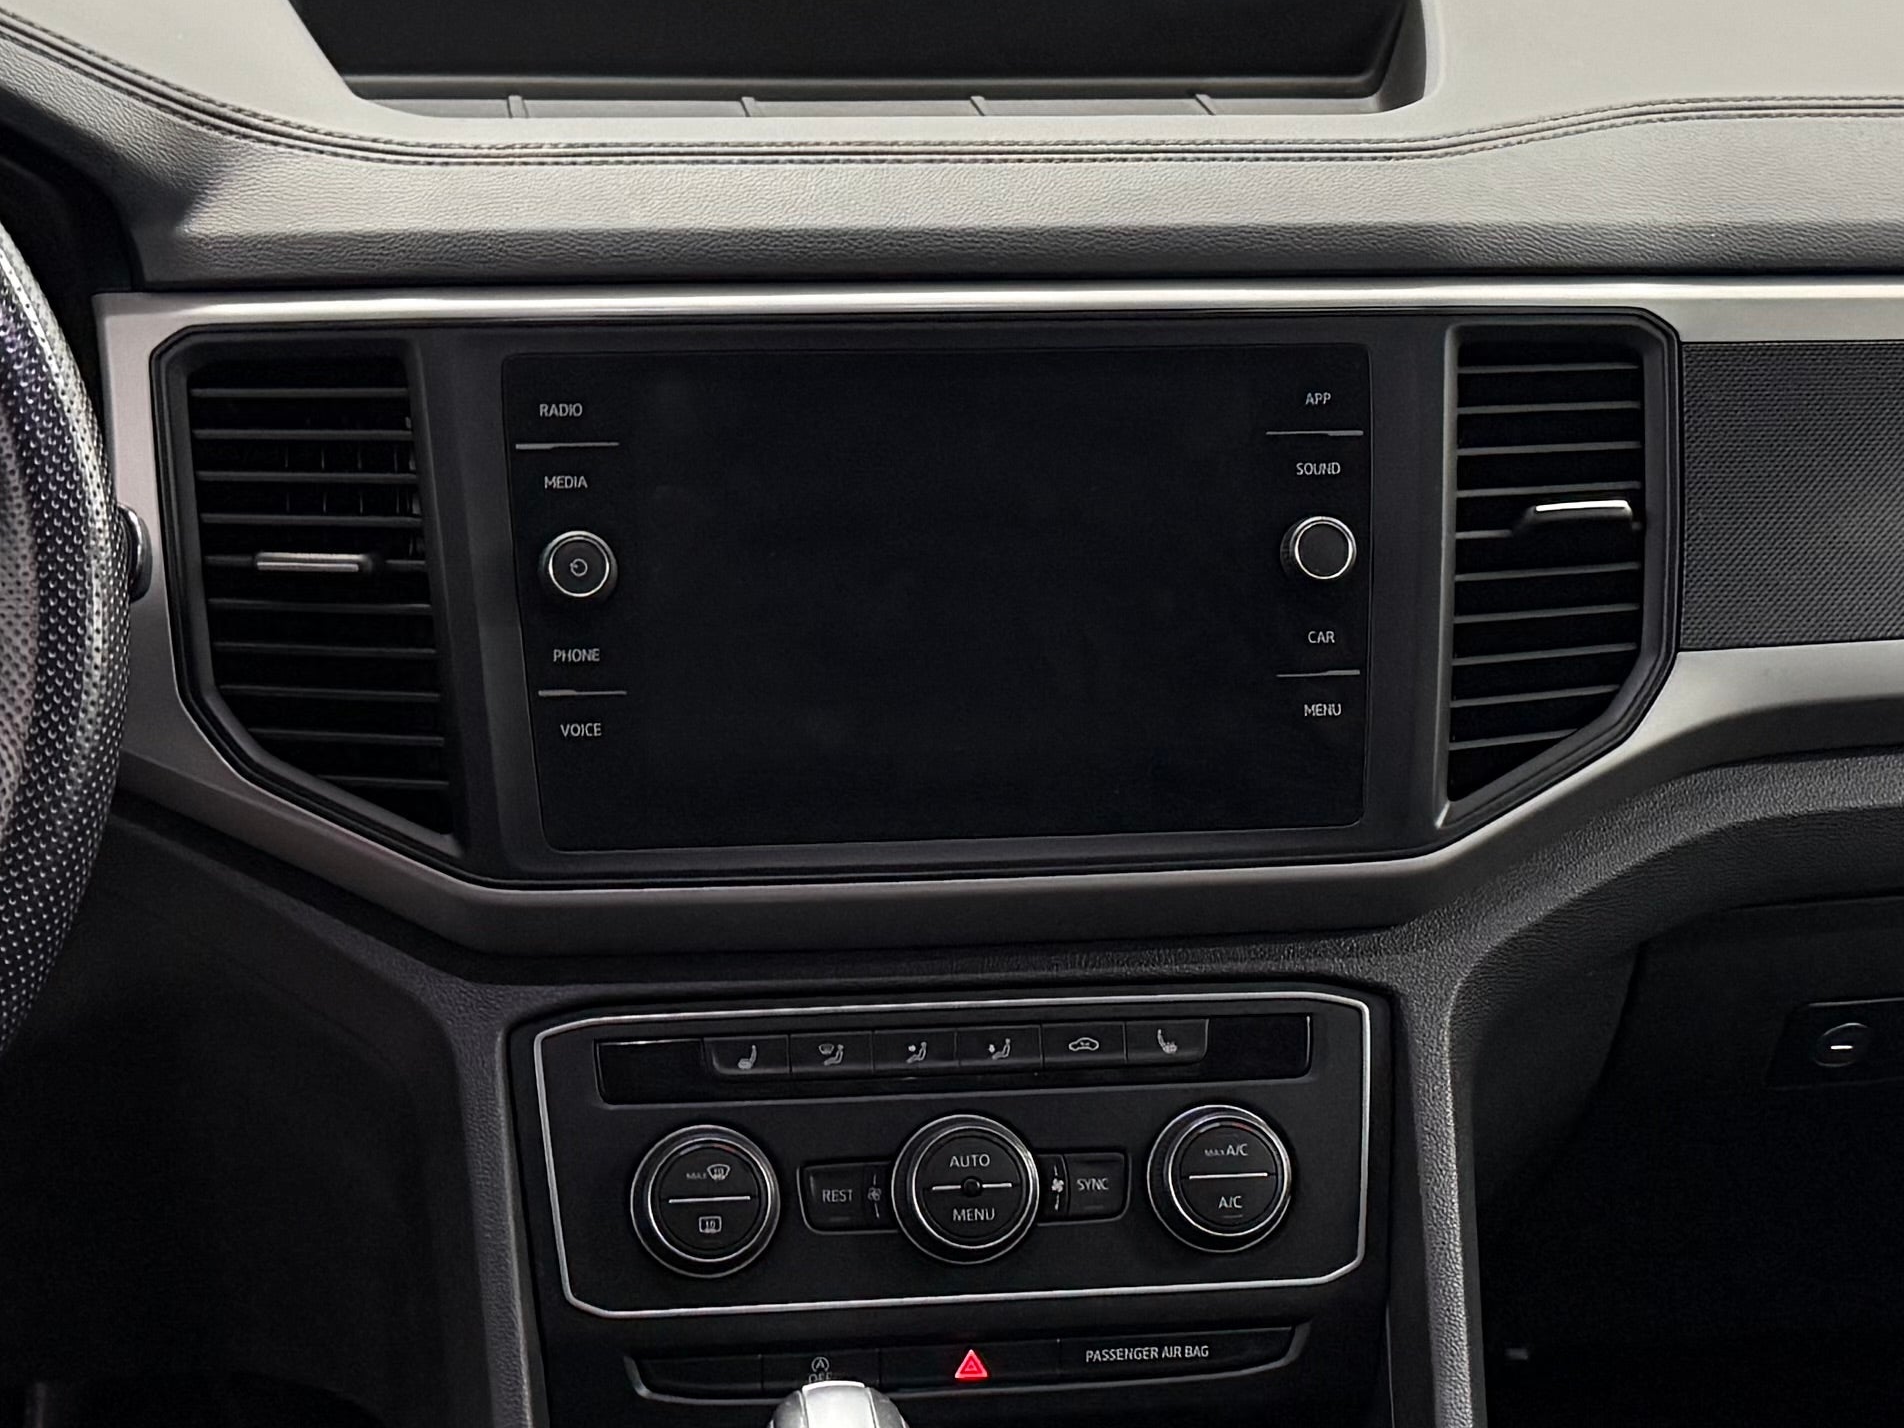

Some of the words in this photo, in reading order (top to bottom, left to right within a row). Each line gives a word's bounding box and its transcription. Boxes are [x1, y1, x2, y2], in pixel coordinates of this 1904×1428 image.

[1305, 392, 1332, 405] APP
[539, 402, 583, 417] RADIO
[1296, 462, 1341, 475] SOUND
[544, 476, 588, 489] MEDIA
[1308, 631, 1335, 644] CAR
[553, 648, 600, 662] PHONE
[1304, 703, 1341, 716] MENU
[560, 723, 602, 737] VOICE
[1226, 1143, 1249, 1156] A/C
[949, 1154, 991, 1168] AUTO
[1076, 1177, 1109, 1191] SYNC
[822, 1188, 853, 1203] REST
[1218, 1195, 1243, 1209] A/C
[952, 1208, 995, 1222] MENU
[1085, 1347, 1159, 1363] PASSENGER
[1161, 1345, 1183, 1359] AIR
[1184, 1344, 1210, 1358] BAG
